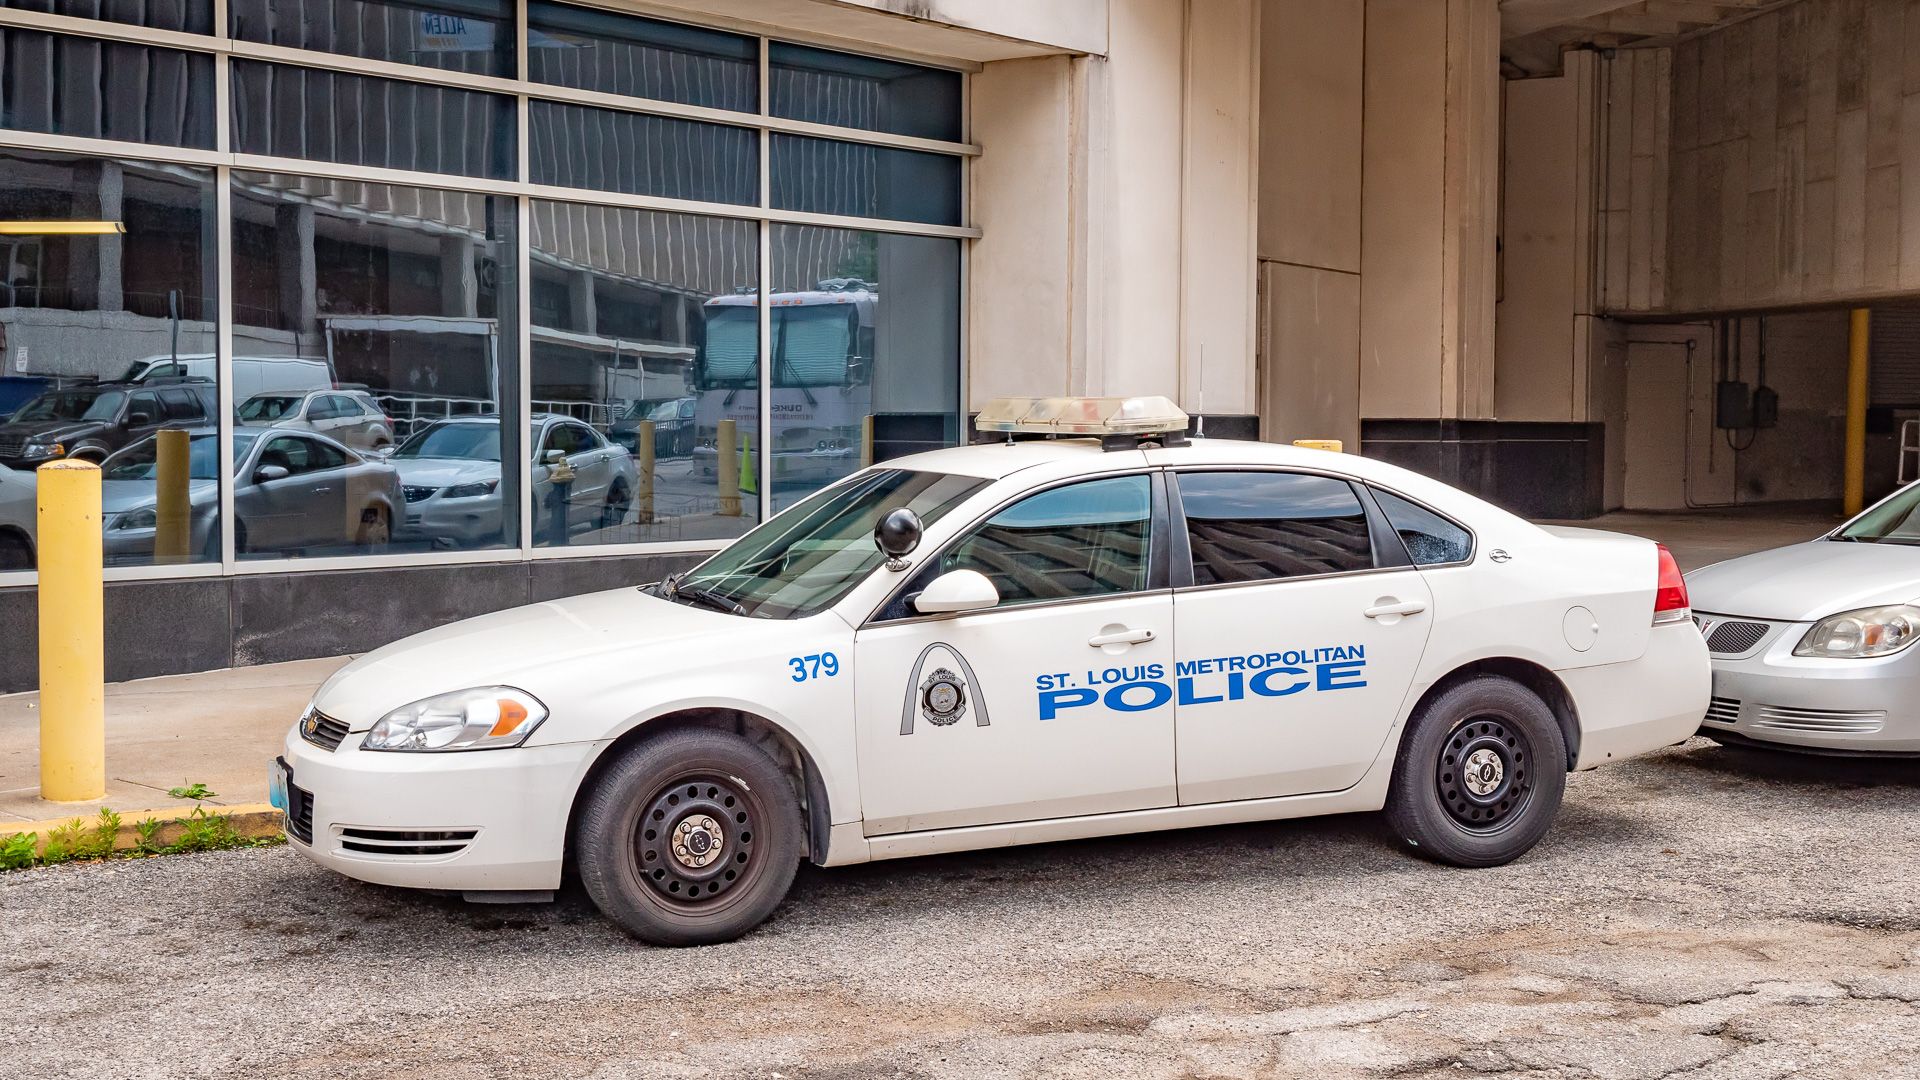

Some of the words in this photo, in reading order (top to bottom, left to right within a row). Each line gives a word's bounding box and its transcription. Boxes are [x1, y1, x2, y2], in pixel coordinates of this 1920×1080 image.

[789, 652, 839, 682] 379
[1036, 673, 1075, 690] ST.
[1088, 664, 1164, 685] LOUIS
[1176, 645, 1365, 676] METROPOLITAN
[1038, 660, 1367, 721] POLICE
[932, 715, 957, 723] POLICE
